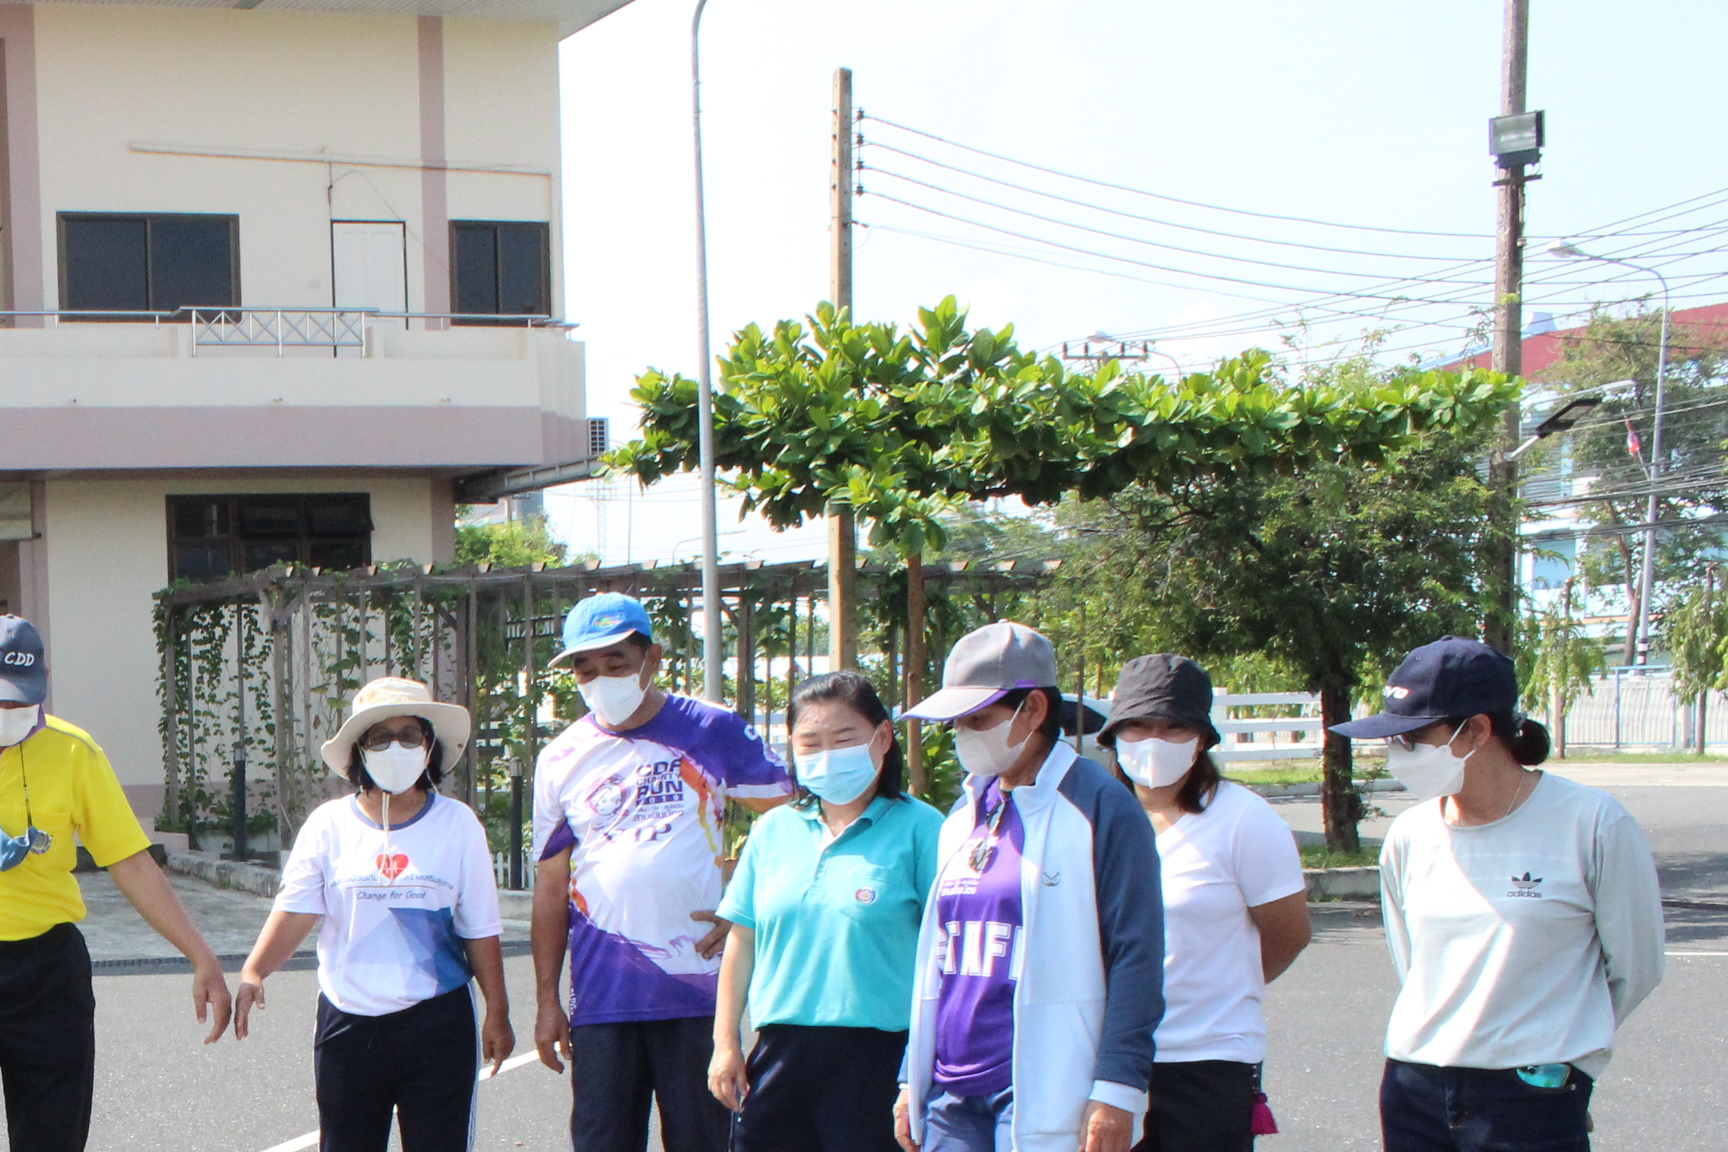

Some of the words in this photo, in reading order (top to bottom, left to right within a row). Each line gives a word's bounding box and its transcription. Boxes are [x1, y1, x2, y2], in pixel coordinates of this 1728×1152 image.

[4, 652, 35, 667] CDD
[636, 781, 682, 801] RUN
[357, 891, 386, 901] Change
[389, 890, 402, 899] for
[405, 890, 426, 899] Good
[1507, 890, 1542, 899] adidas
